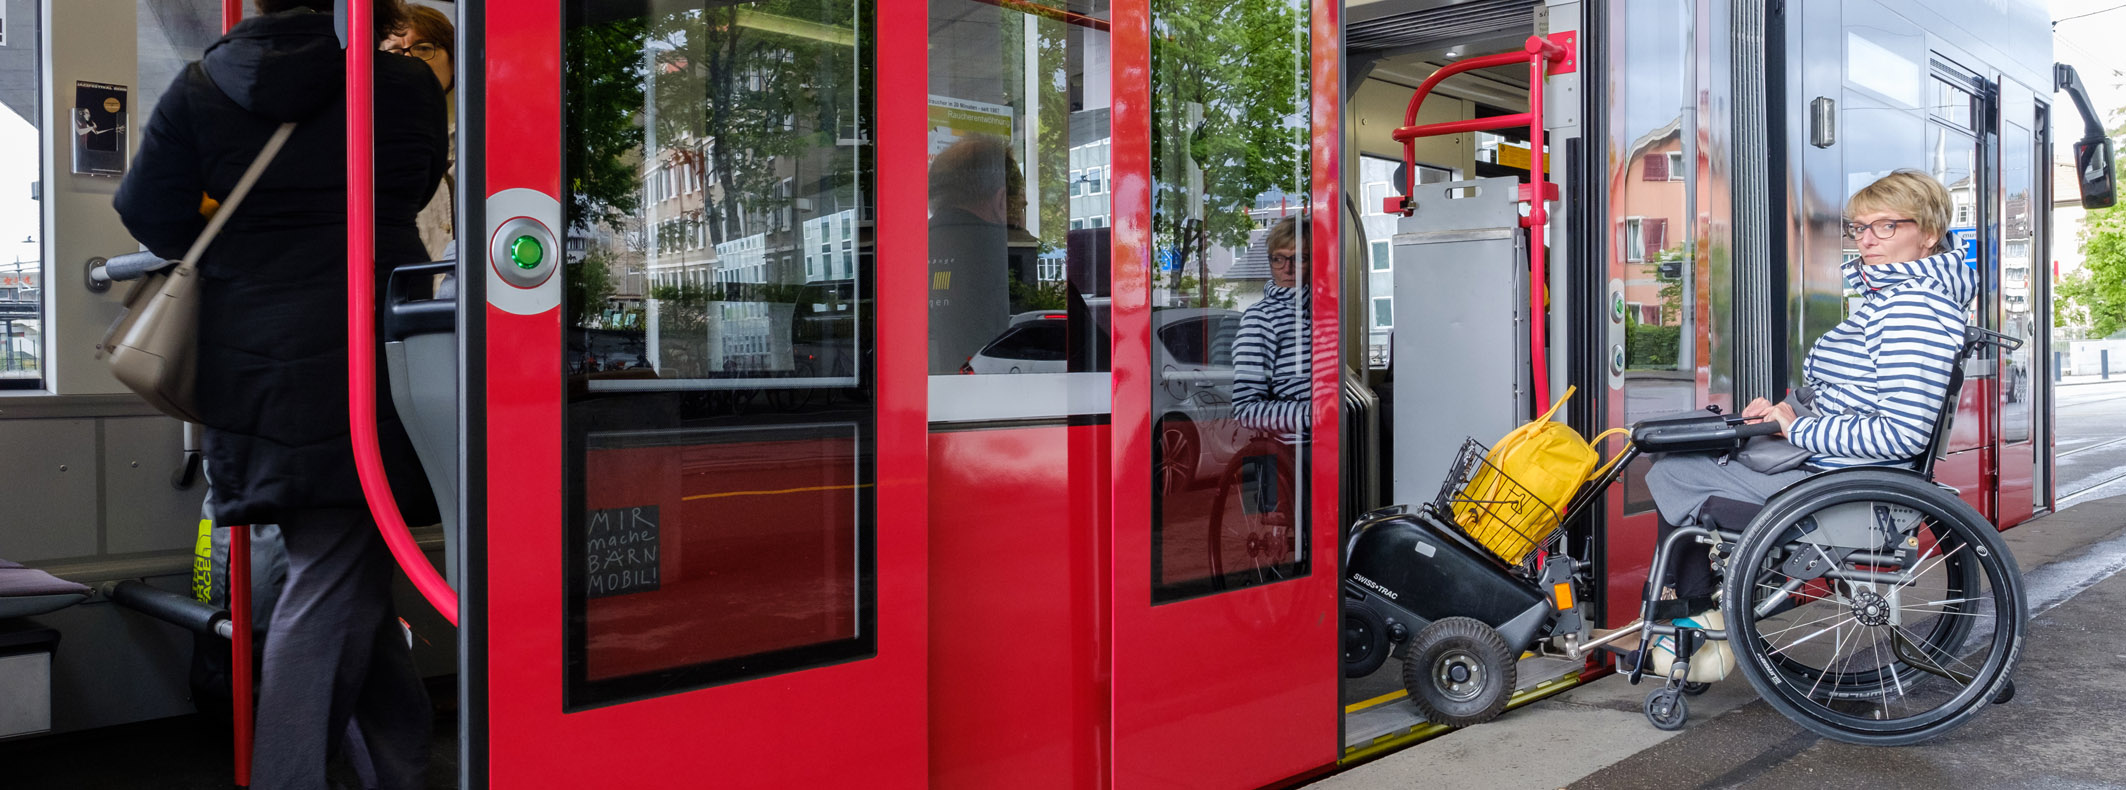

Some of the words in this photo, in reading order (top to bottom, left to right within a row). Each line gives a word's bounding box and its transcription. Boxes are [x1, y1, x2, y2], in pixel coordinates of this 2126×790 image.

[947, 110, 1011, 128] Raucherentwöhnung
[588, 507, 656, 535] MIR
[587, 530, 656, 554] mache
[588, 545, 657, 574] BÄRN
[587, 567, 657, 596] MOBIL!
[1968, 635, 2022, 715] SCHWALBE
